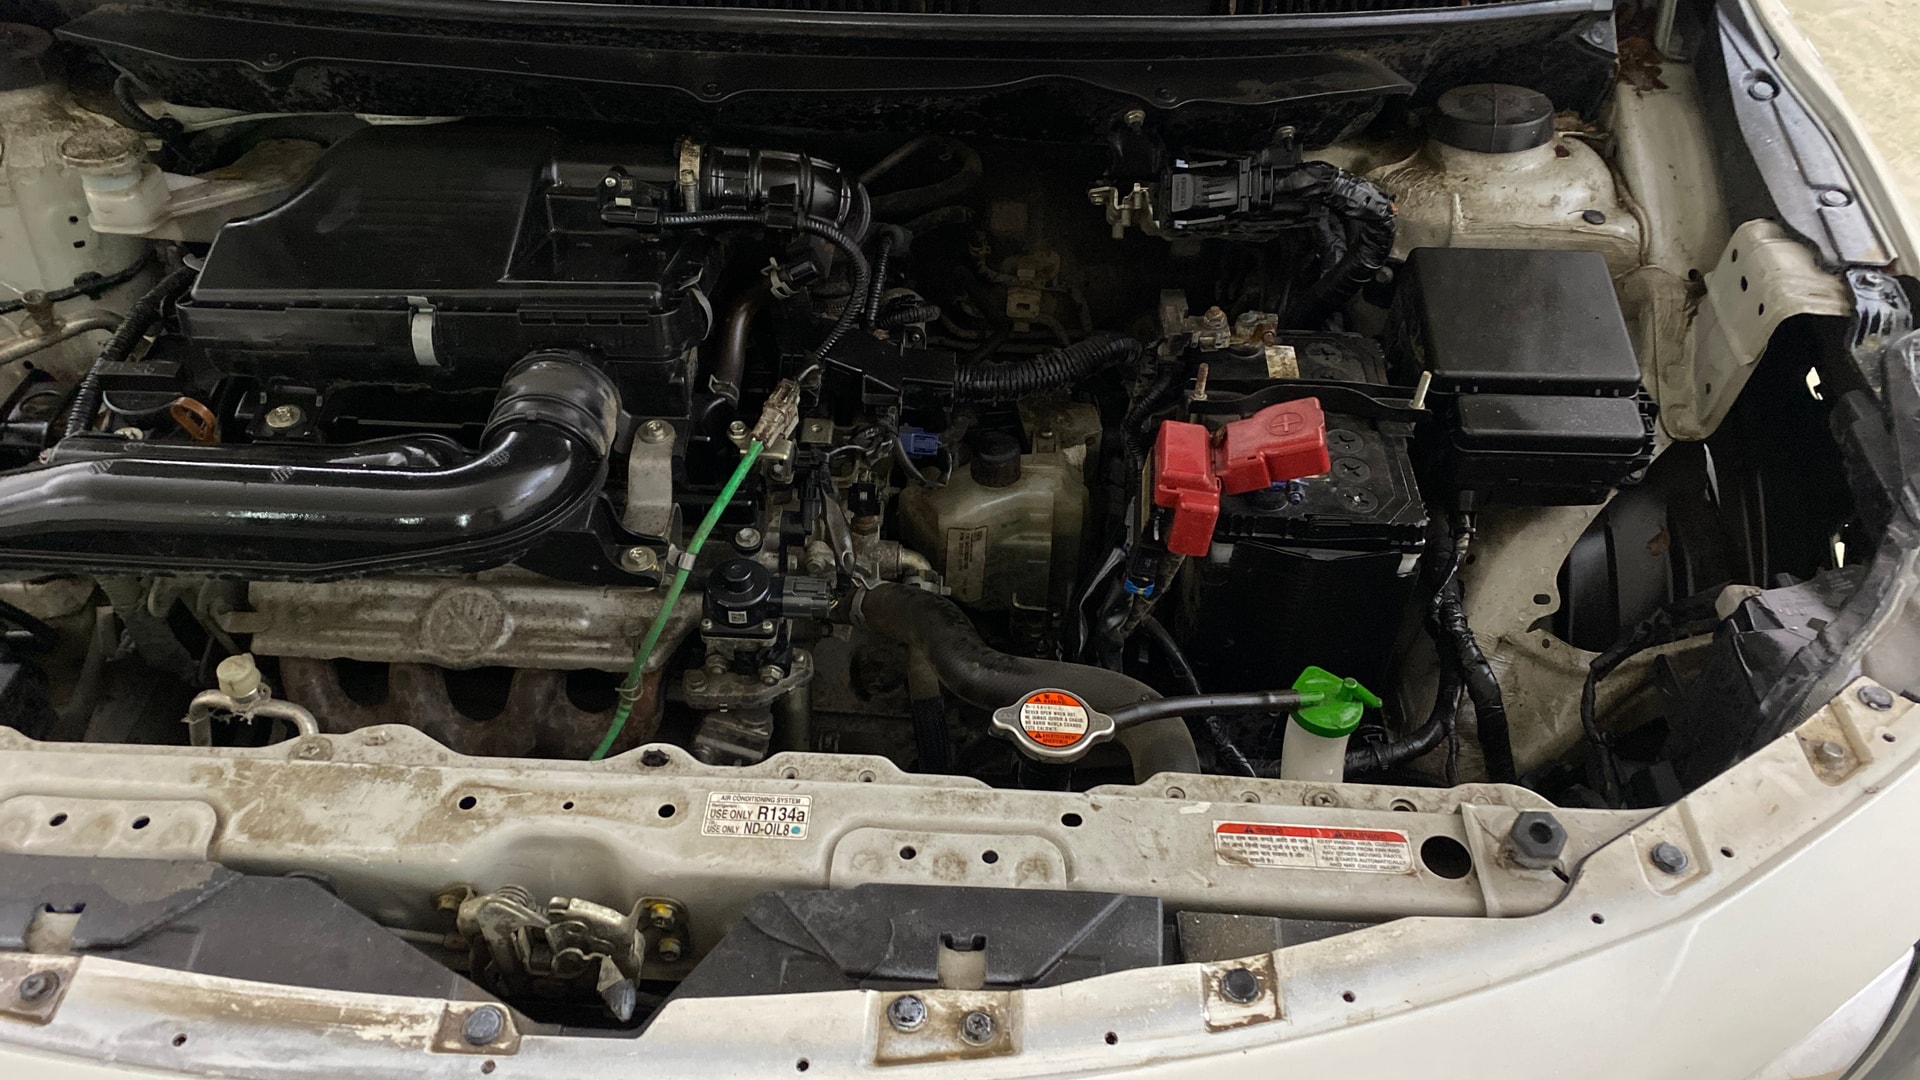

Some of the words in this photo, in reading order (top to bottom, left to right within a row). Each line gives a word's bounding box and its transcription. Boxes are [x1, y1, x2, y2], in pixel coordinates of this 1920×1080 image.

[710, 809, 728, 819] USE
[730, 810, 753, 820] ONLY
[757, 806, 805, 821] R134a
[707, 824, 721, 833] USE
[722, 826, 740, 834] ONLY
[744, 822, 790, 836] ND-OIL8
